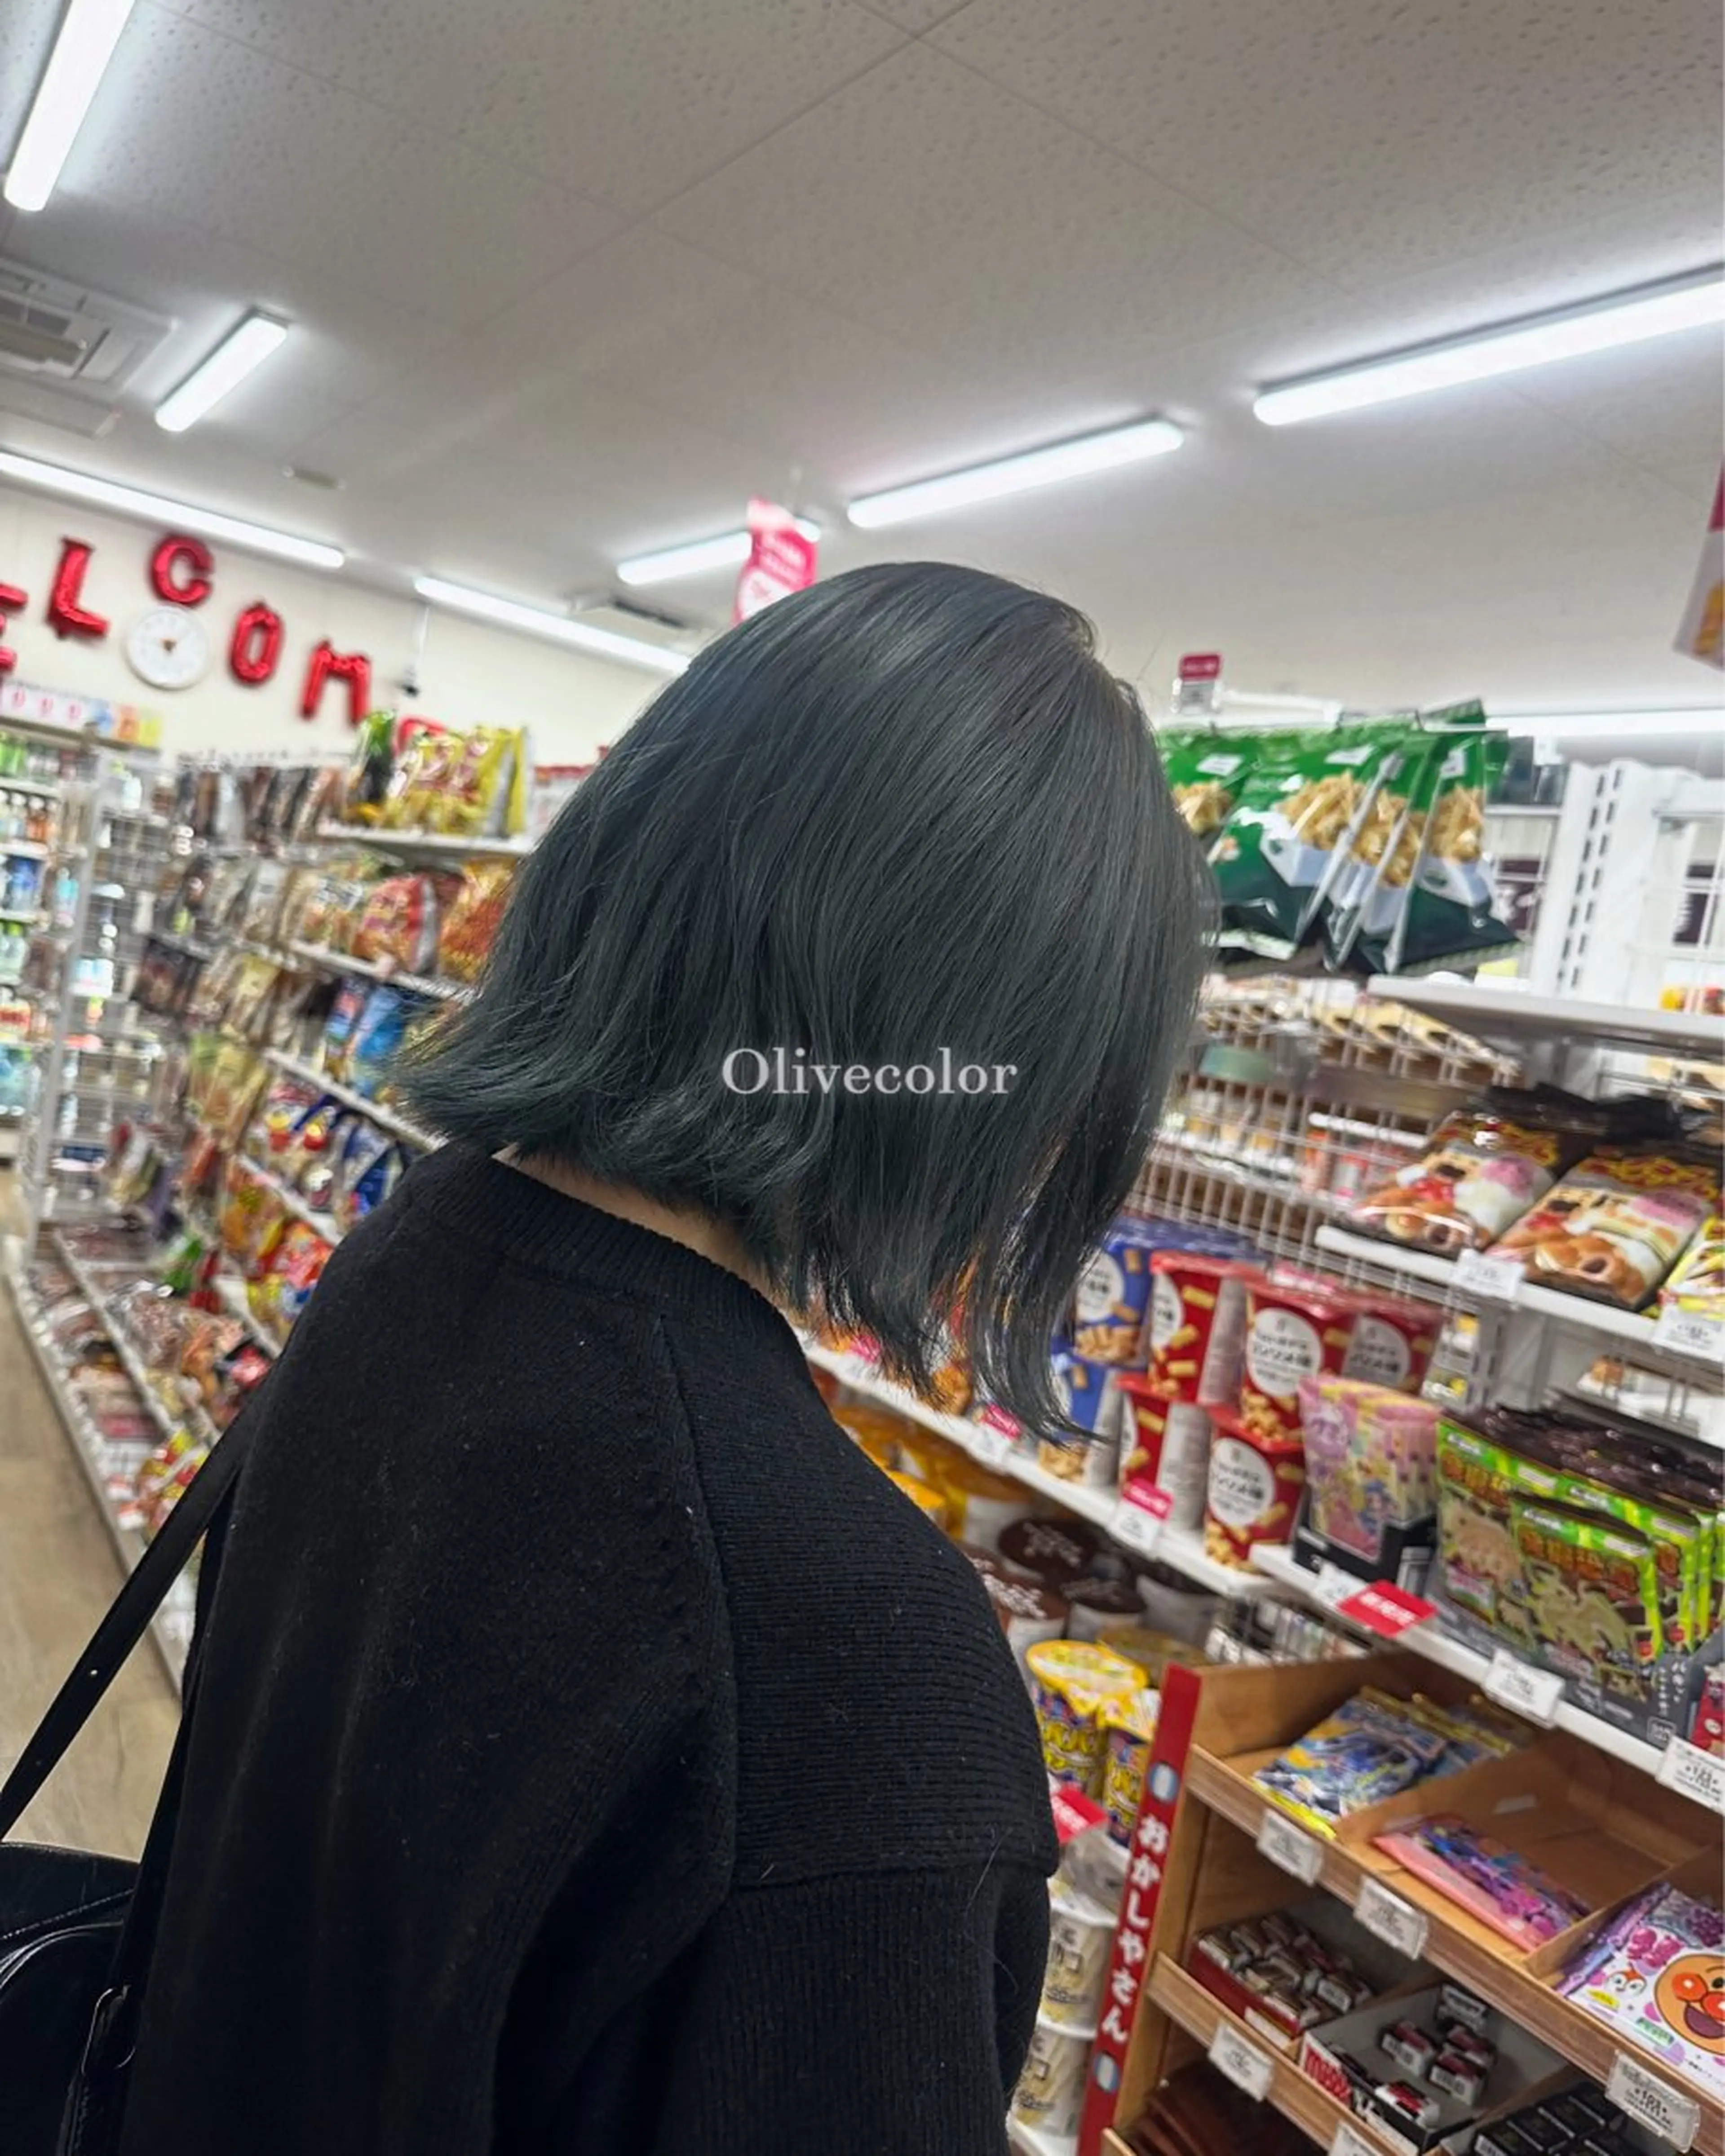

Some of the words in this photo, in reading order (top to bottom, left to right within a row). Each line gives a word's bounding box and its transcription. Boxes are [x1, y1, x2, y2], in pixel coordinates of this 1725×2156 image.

[1101, 1813, 1168, 2043] おかしやさん
